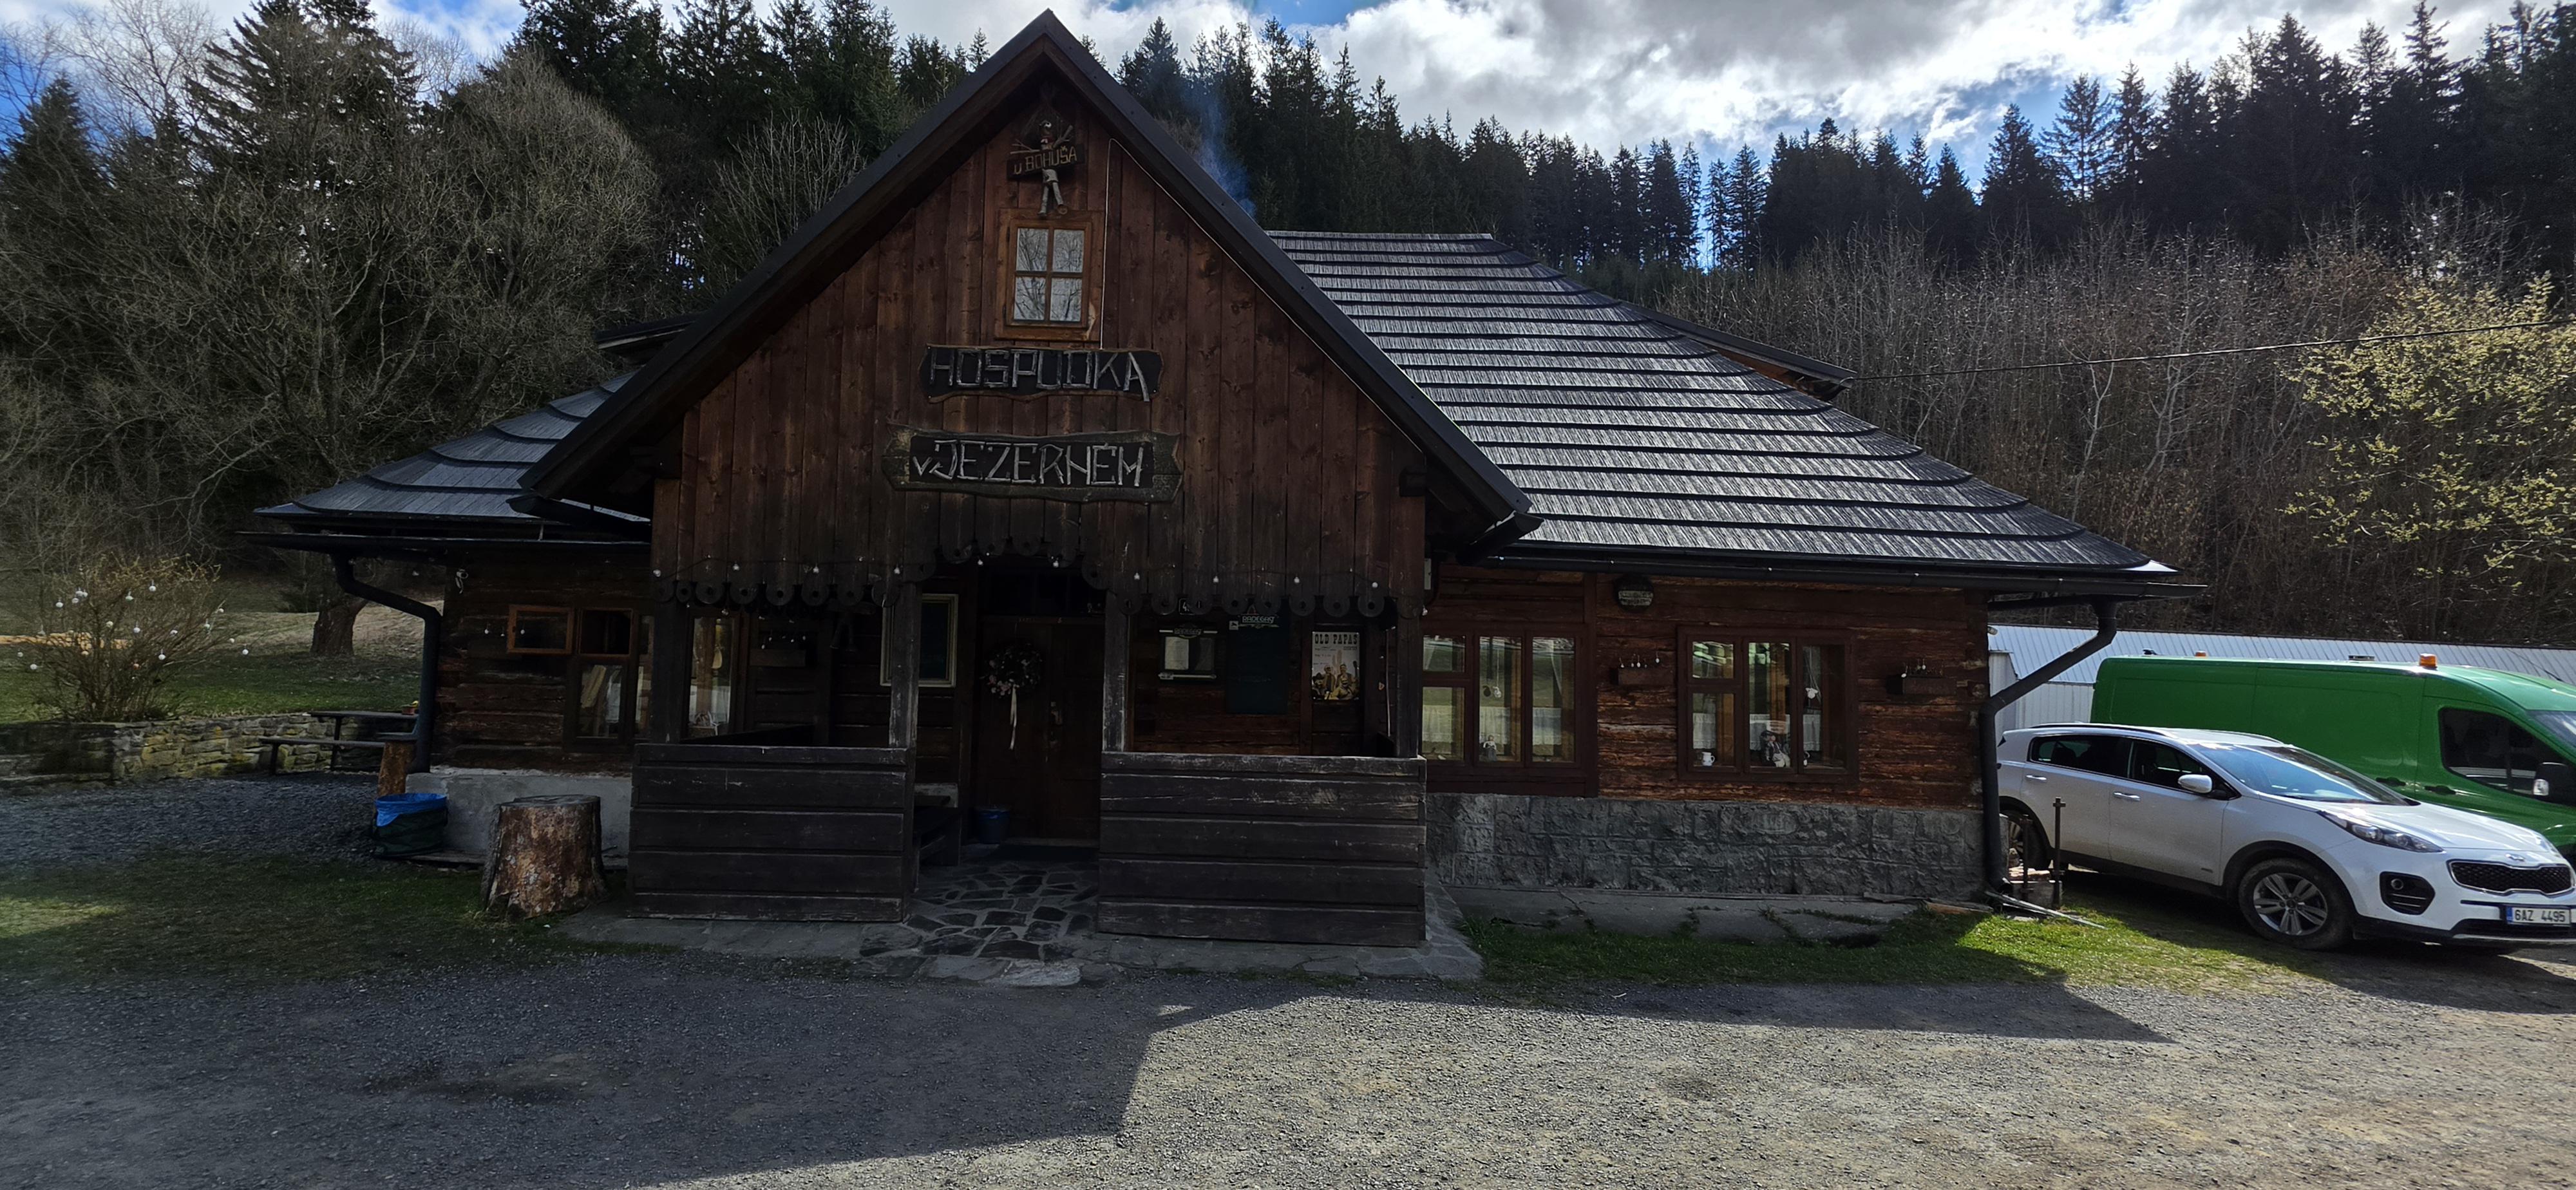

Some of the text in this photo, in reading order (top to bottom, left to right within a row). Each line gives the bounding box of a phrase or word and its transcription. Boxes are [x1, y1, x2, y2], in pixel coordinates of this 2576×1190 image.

[1024, 145, 1077, 172] BOHUŠA
[930, 349, 1150, 402] HOSPUDKA
[1314, 634, 1357, 644] OLD PAPAS
[2514, 909, 2566, 922] 6AZ 4495
